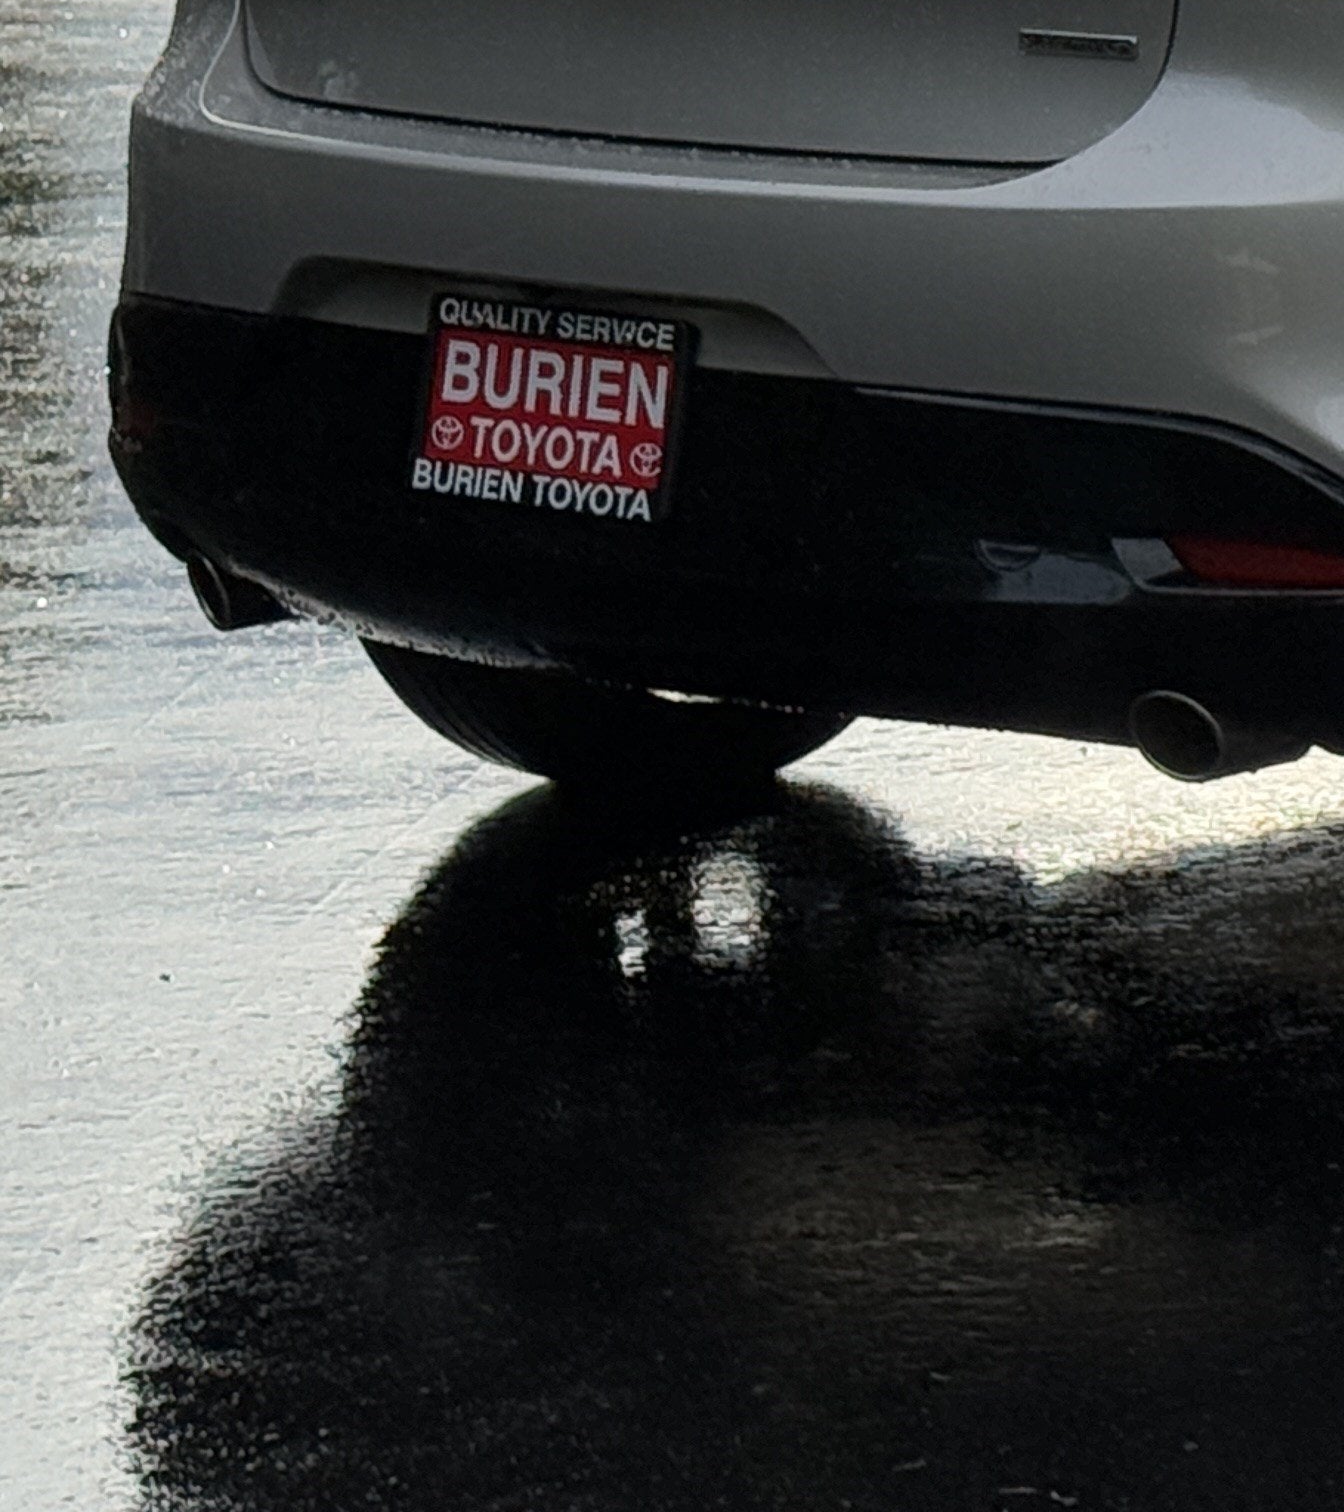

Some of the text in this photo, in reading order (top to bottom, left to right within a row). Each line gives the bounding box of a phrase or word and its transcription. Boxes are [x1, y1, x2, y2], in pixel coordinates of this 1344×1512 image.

[439, 297, 676, 352] QUALITY SERVICE
[441, 338, 669, 430] BURIEN
[469, 415, 623, 478] TOYOTA
[411, 457, 652, 523] BURIEN TOYOTA
